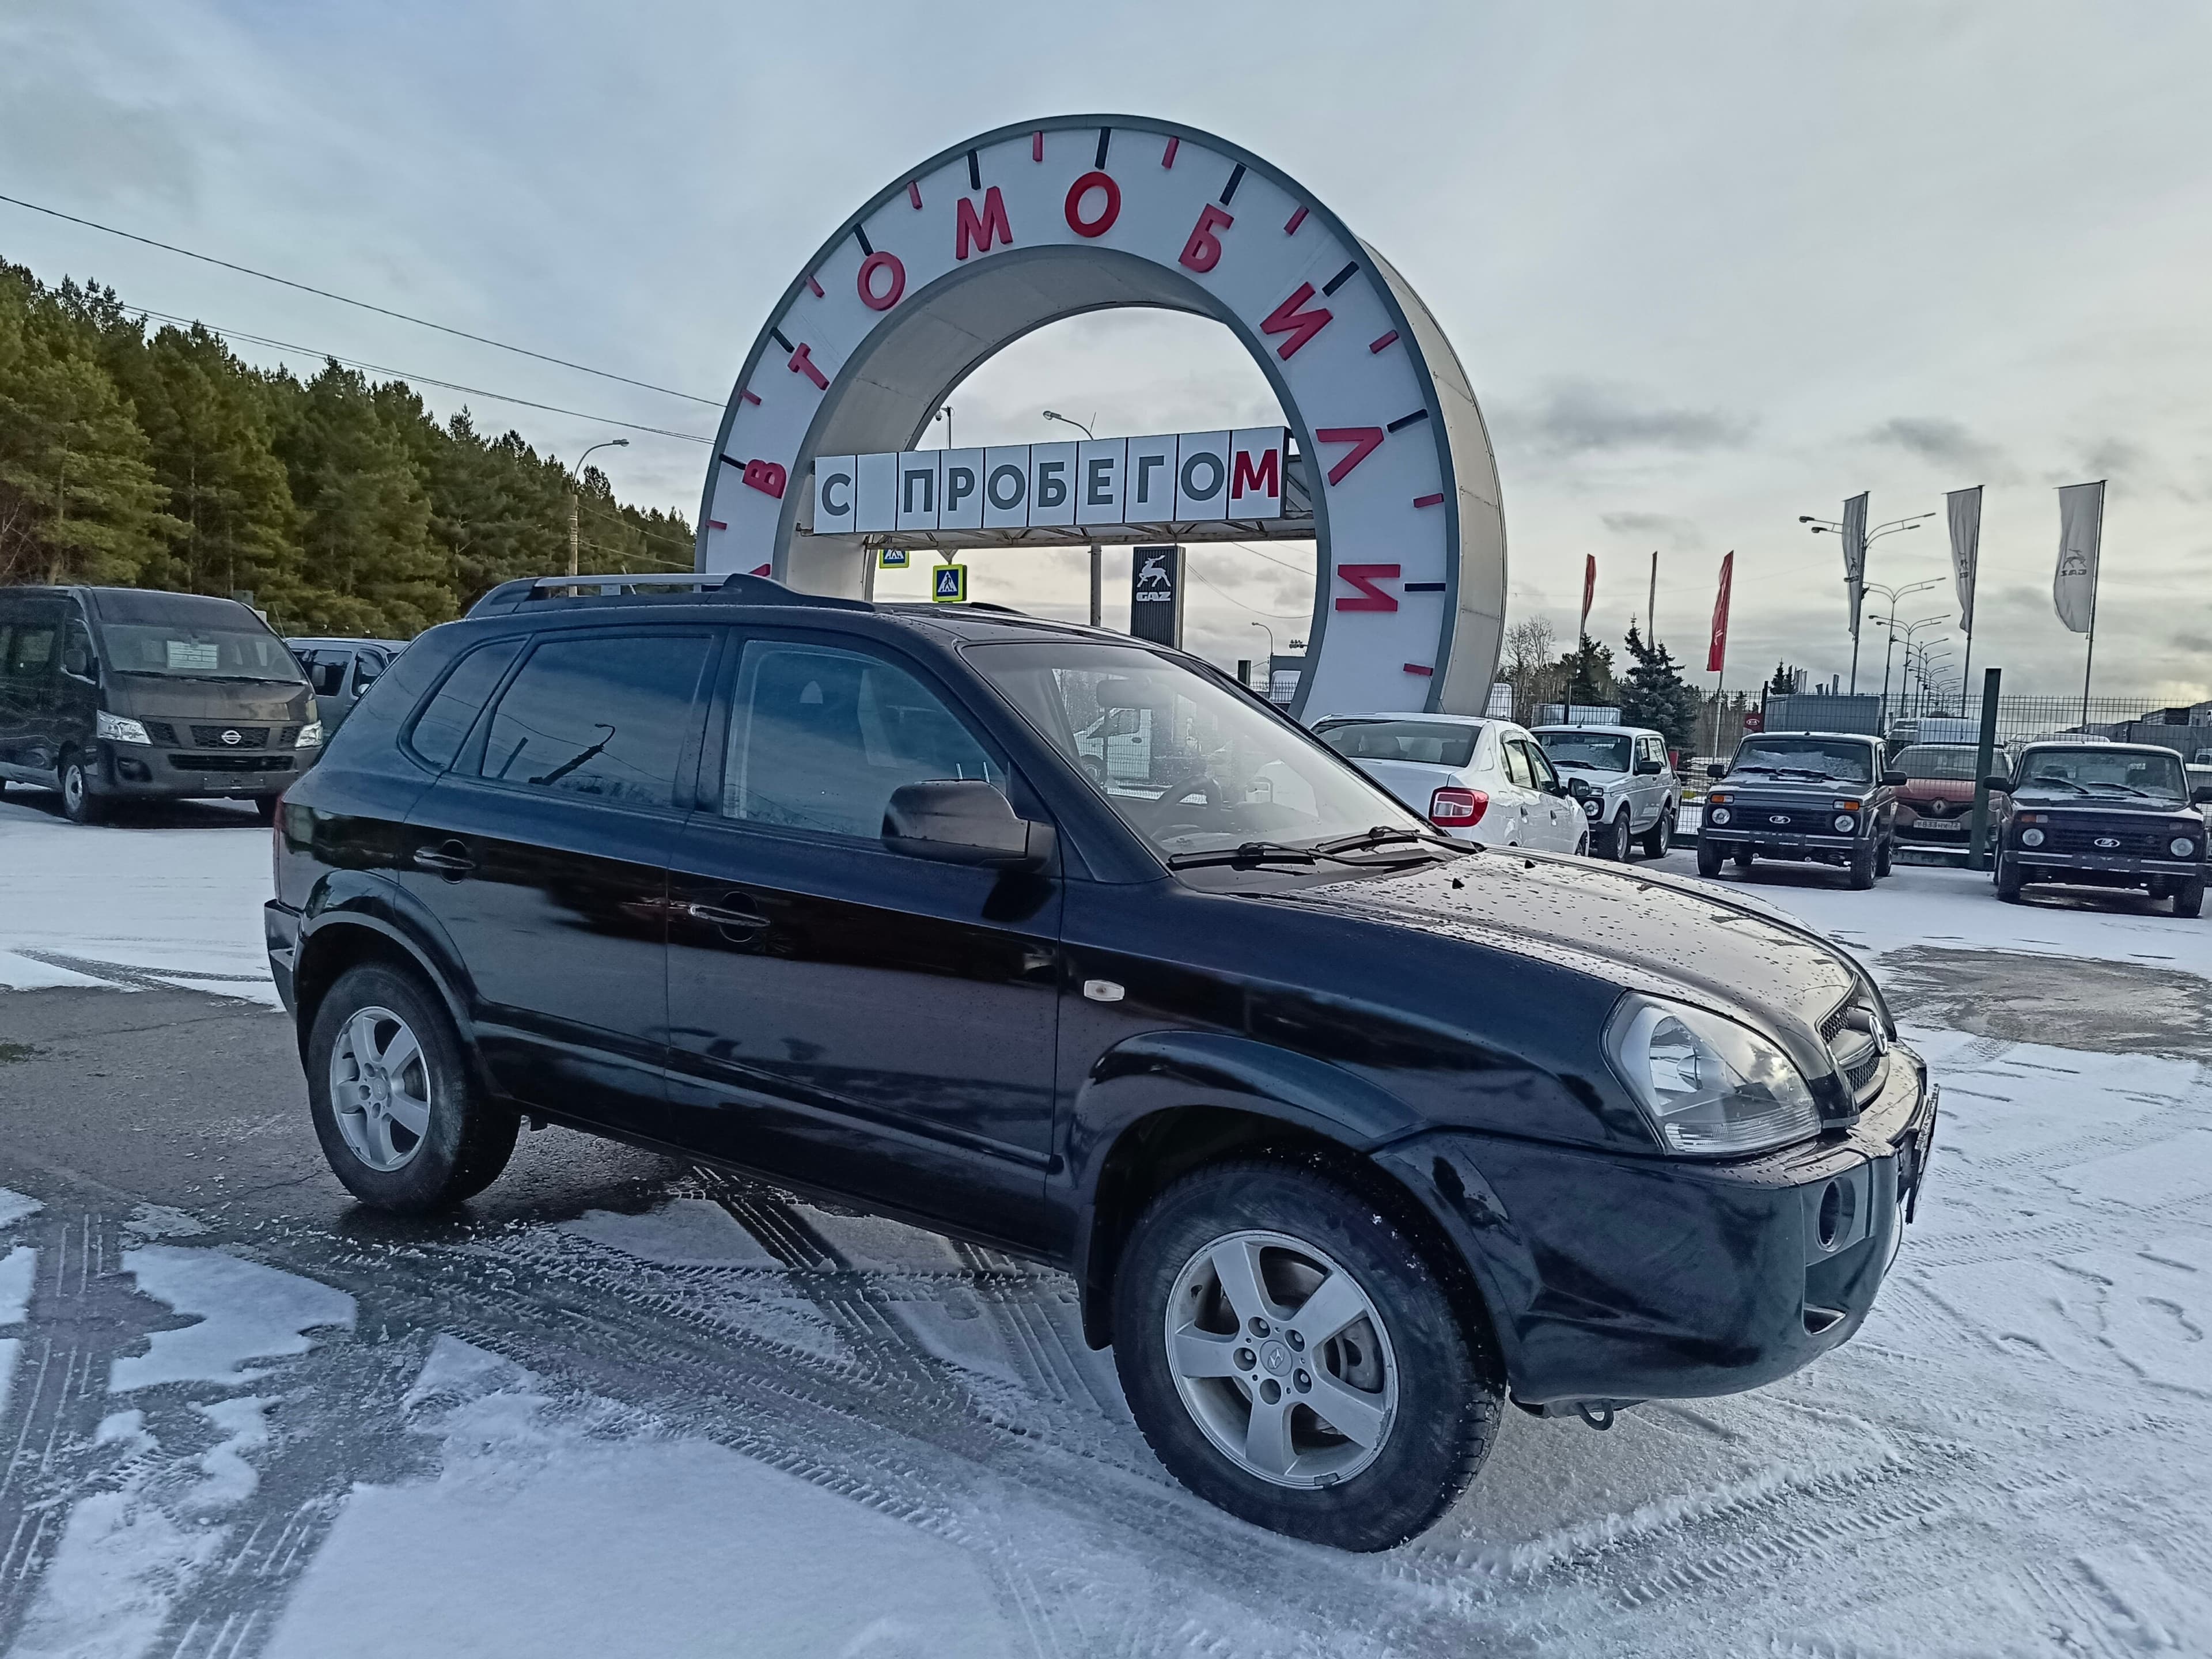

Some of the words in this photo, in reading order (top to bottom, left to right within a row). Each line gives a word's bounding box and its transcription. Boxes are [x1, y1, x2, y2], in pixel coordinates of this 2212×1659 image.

[742, 171, 1401, 612] ВТОМОБИЛИ
[821, 472, 851, 517] С
[903, 448, 1279, 513] ПРОБЕГОМ
[1136, 591, 1171, 601] GAZ
